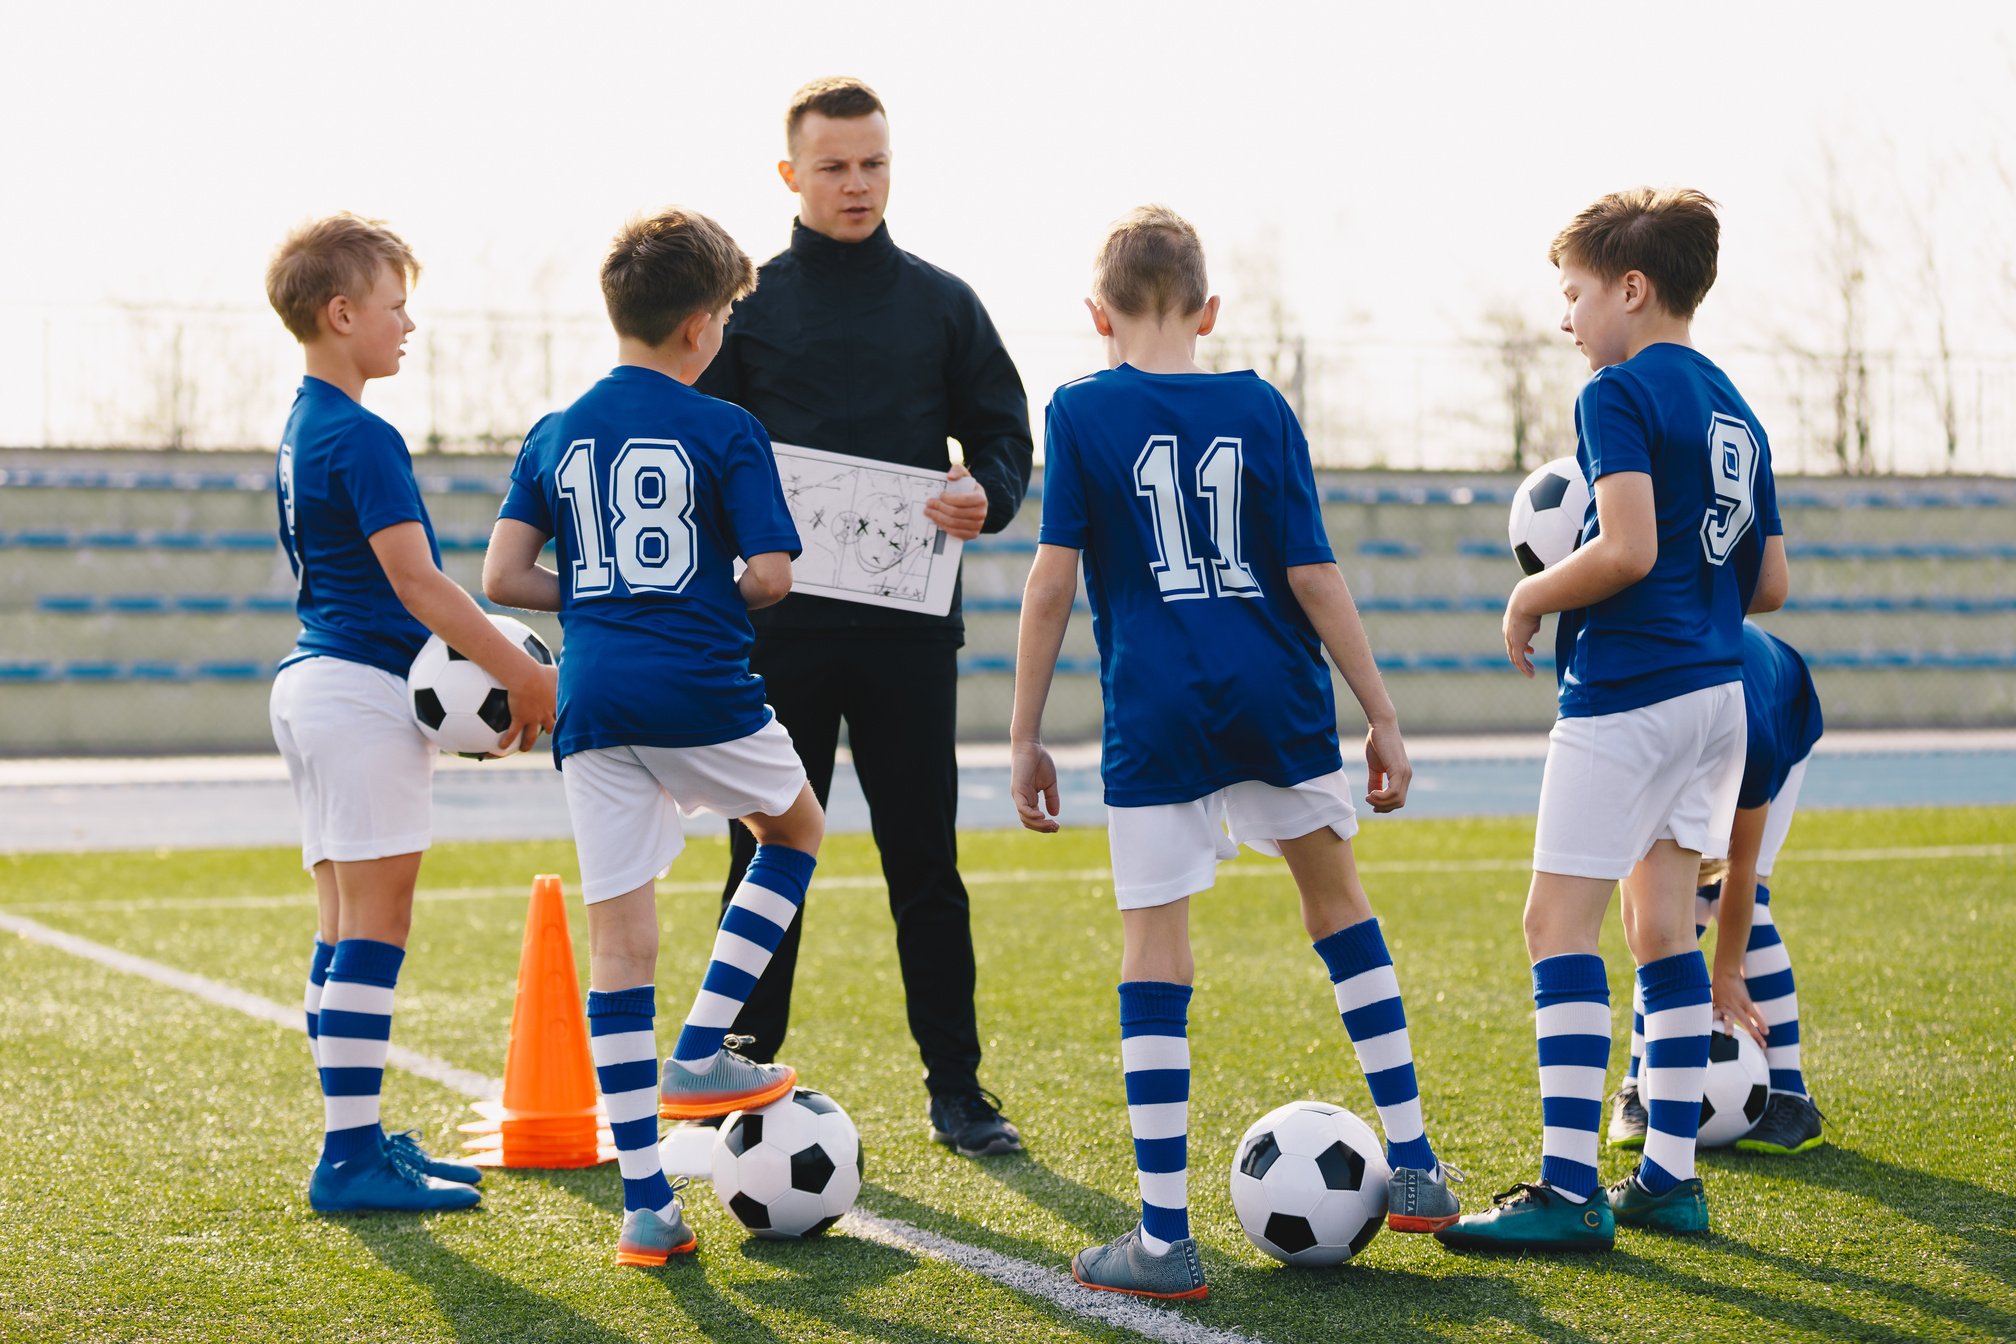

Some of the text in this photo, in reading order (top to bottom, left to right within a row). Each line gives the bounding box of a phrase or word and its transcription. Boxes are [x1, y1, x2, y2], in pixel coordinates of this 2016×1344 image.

[555, 438, 697, 599] 18
[1133, 435, 1264, 602] 11
[1699, 411, 1760, 566] 9
[1185, 1245, 1199, 1285] KIPSTA
[1407, 1174, 1416, 1212] KIPSTA
